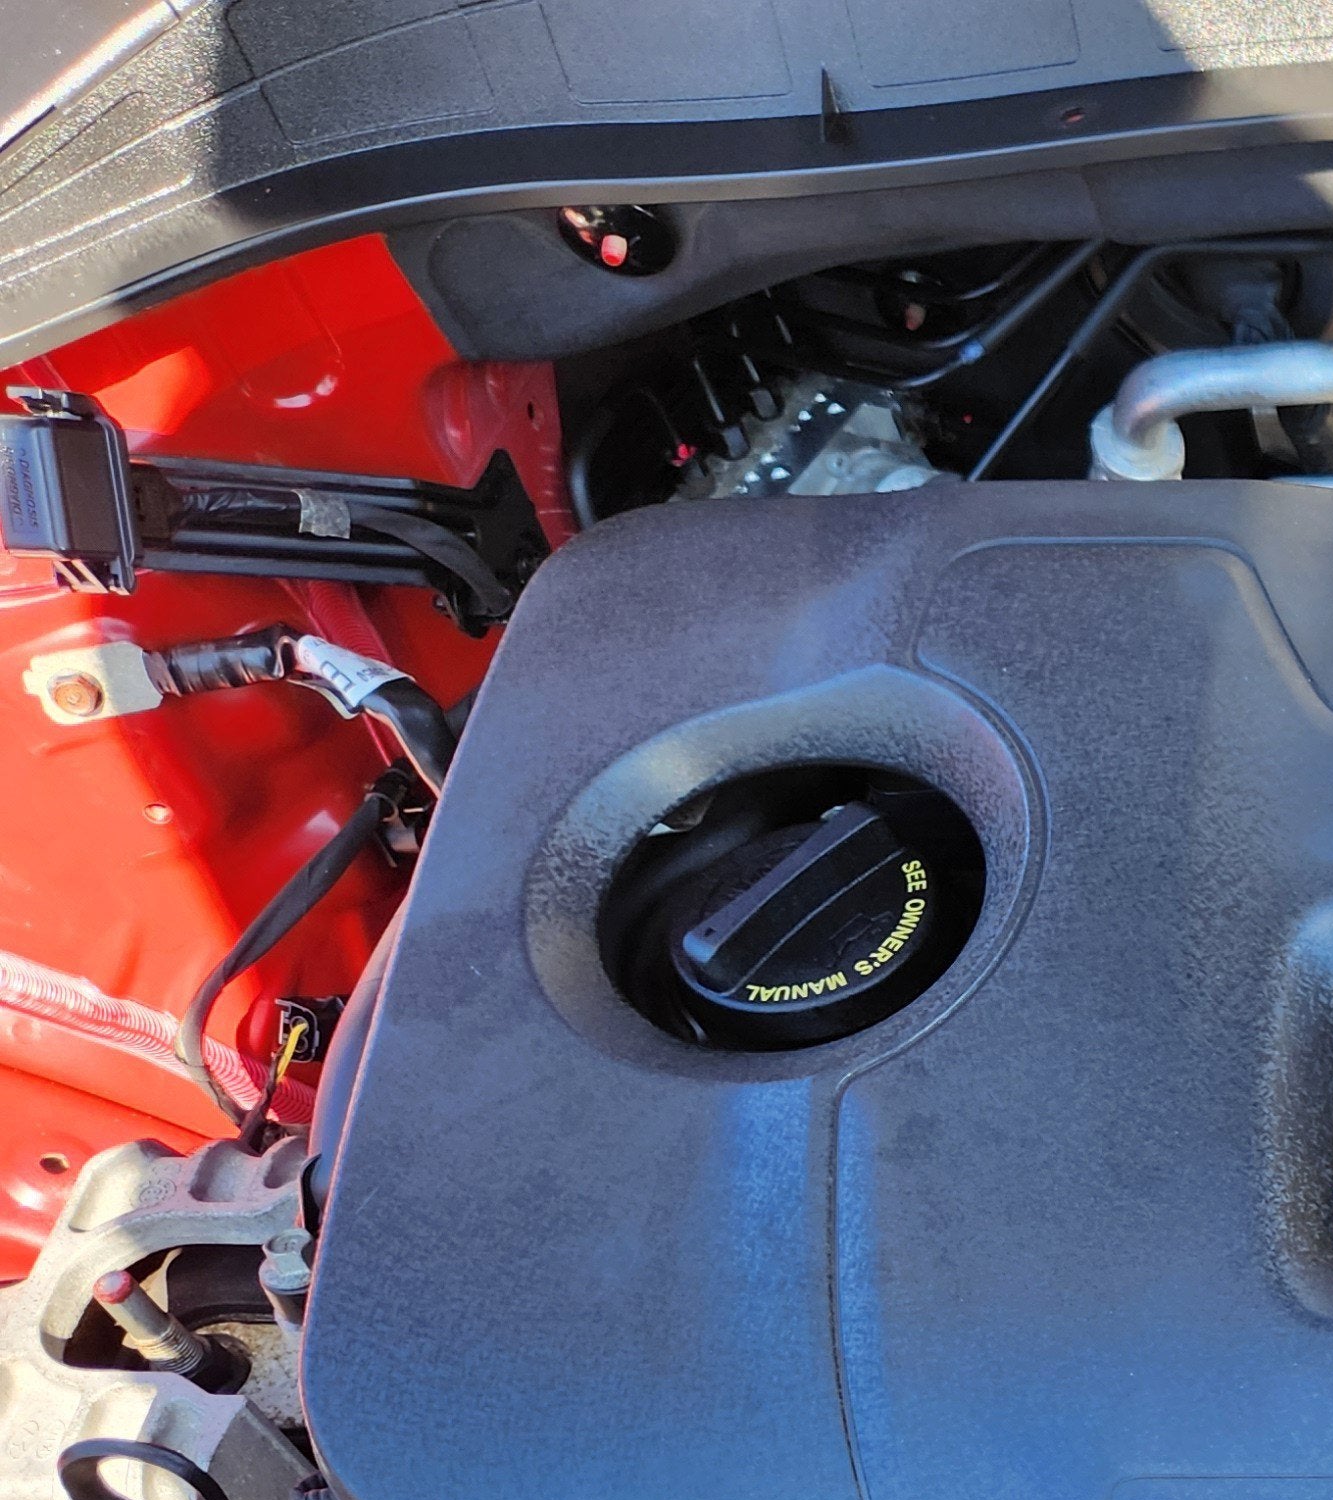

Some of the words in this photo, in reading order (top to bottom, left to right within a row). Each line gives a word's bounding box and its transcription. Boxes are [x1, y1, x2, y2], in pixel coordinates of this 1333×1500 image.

[902, 860, 927, 893] SEE
[854, 898, 925, 975] OWNER'S
[746, 971, 848, 1002] MANUAL
